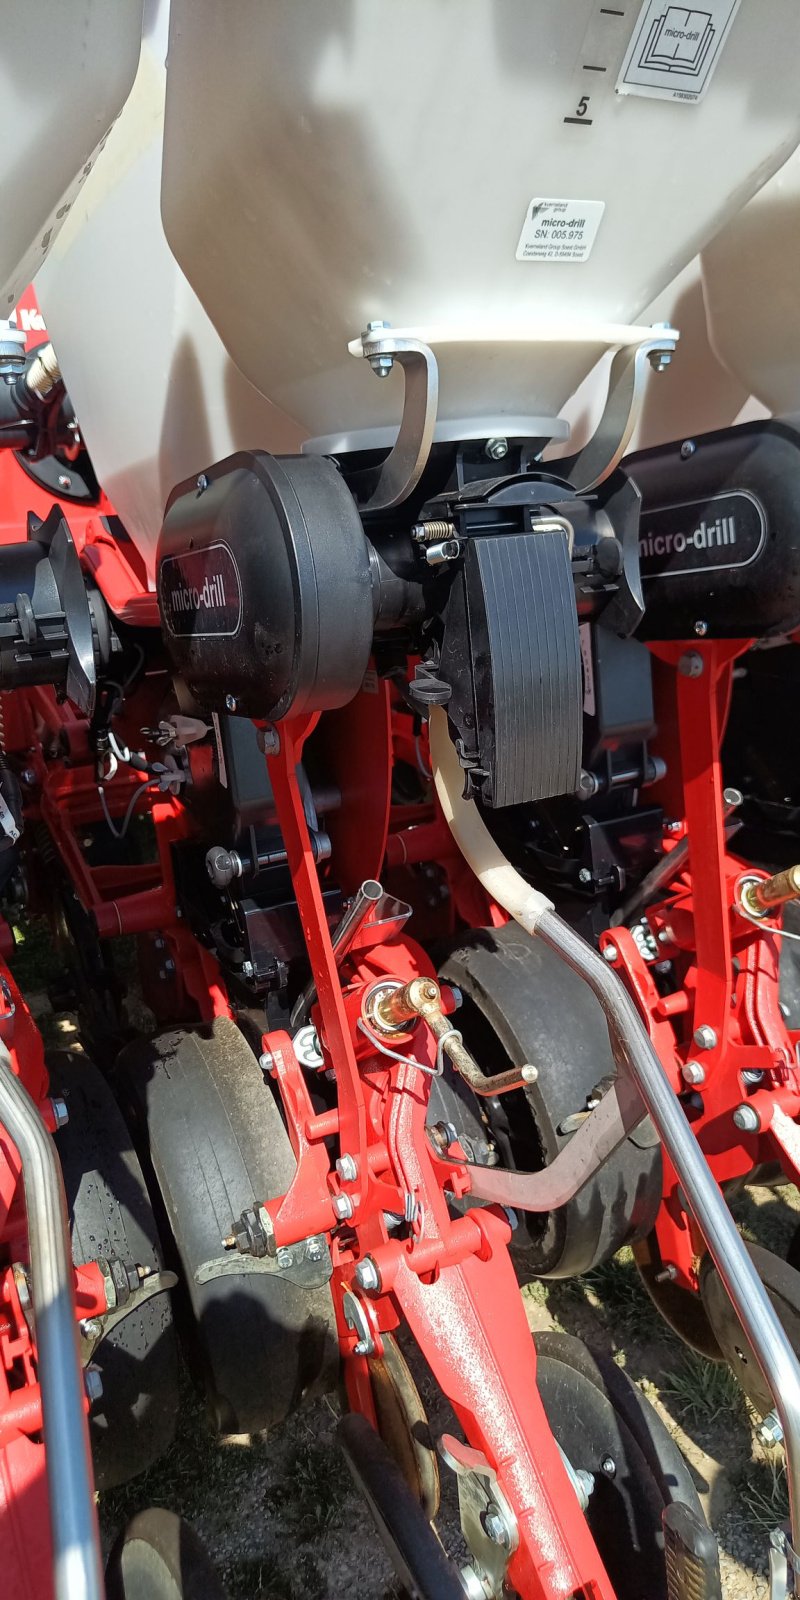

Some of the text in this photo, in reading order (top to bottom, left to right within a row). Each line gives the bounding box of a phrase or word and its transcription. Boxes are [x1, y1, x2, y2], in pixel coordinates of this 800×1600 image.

[664, 28, 700, 41] micro-drill
[575, 96, 590, 117] 5
[541, 218, 586, 228] micro-drill
[534, 229, 584, 240] SN: 005.975
[171, 574, 226, 612] micro-drill
